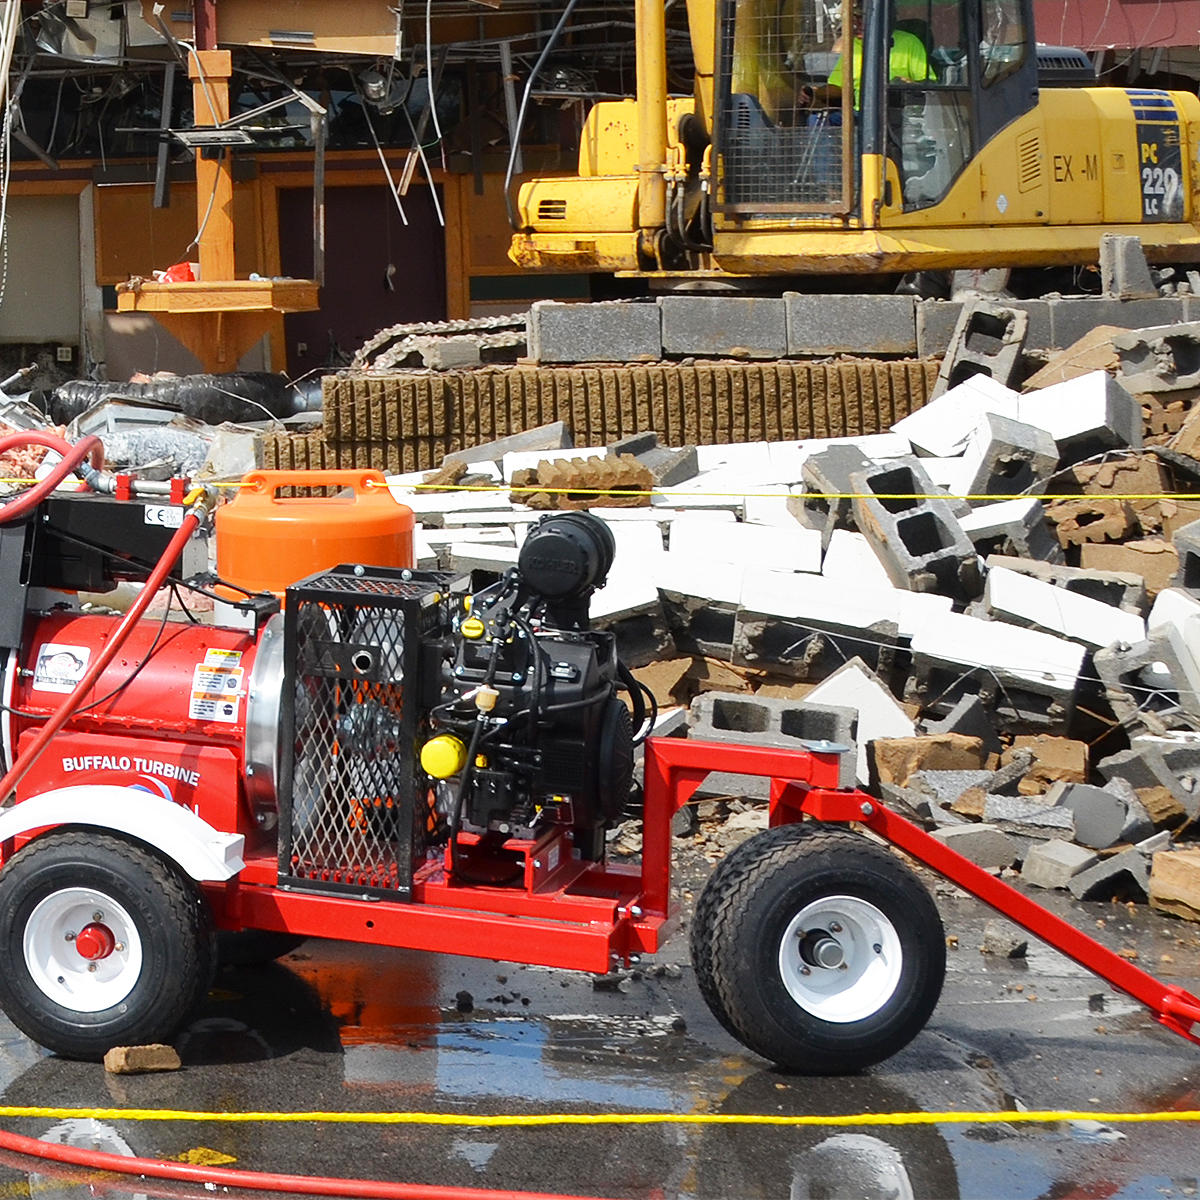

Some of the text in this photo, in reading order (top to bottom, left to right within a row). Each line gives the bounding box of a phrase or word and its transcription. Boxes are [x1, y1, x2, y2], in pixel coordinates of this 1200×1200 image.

[1141, 143, 1157, 164] PC
[1053, 155, 1073, 182] EX
[1145, 198, 1158, 215] LC
[62, 756, 200, 786] BUFFALO TURBINE
